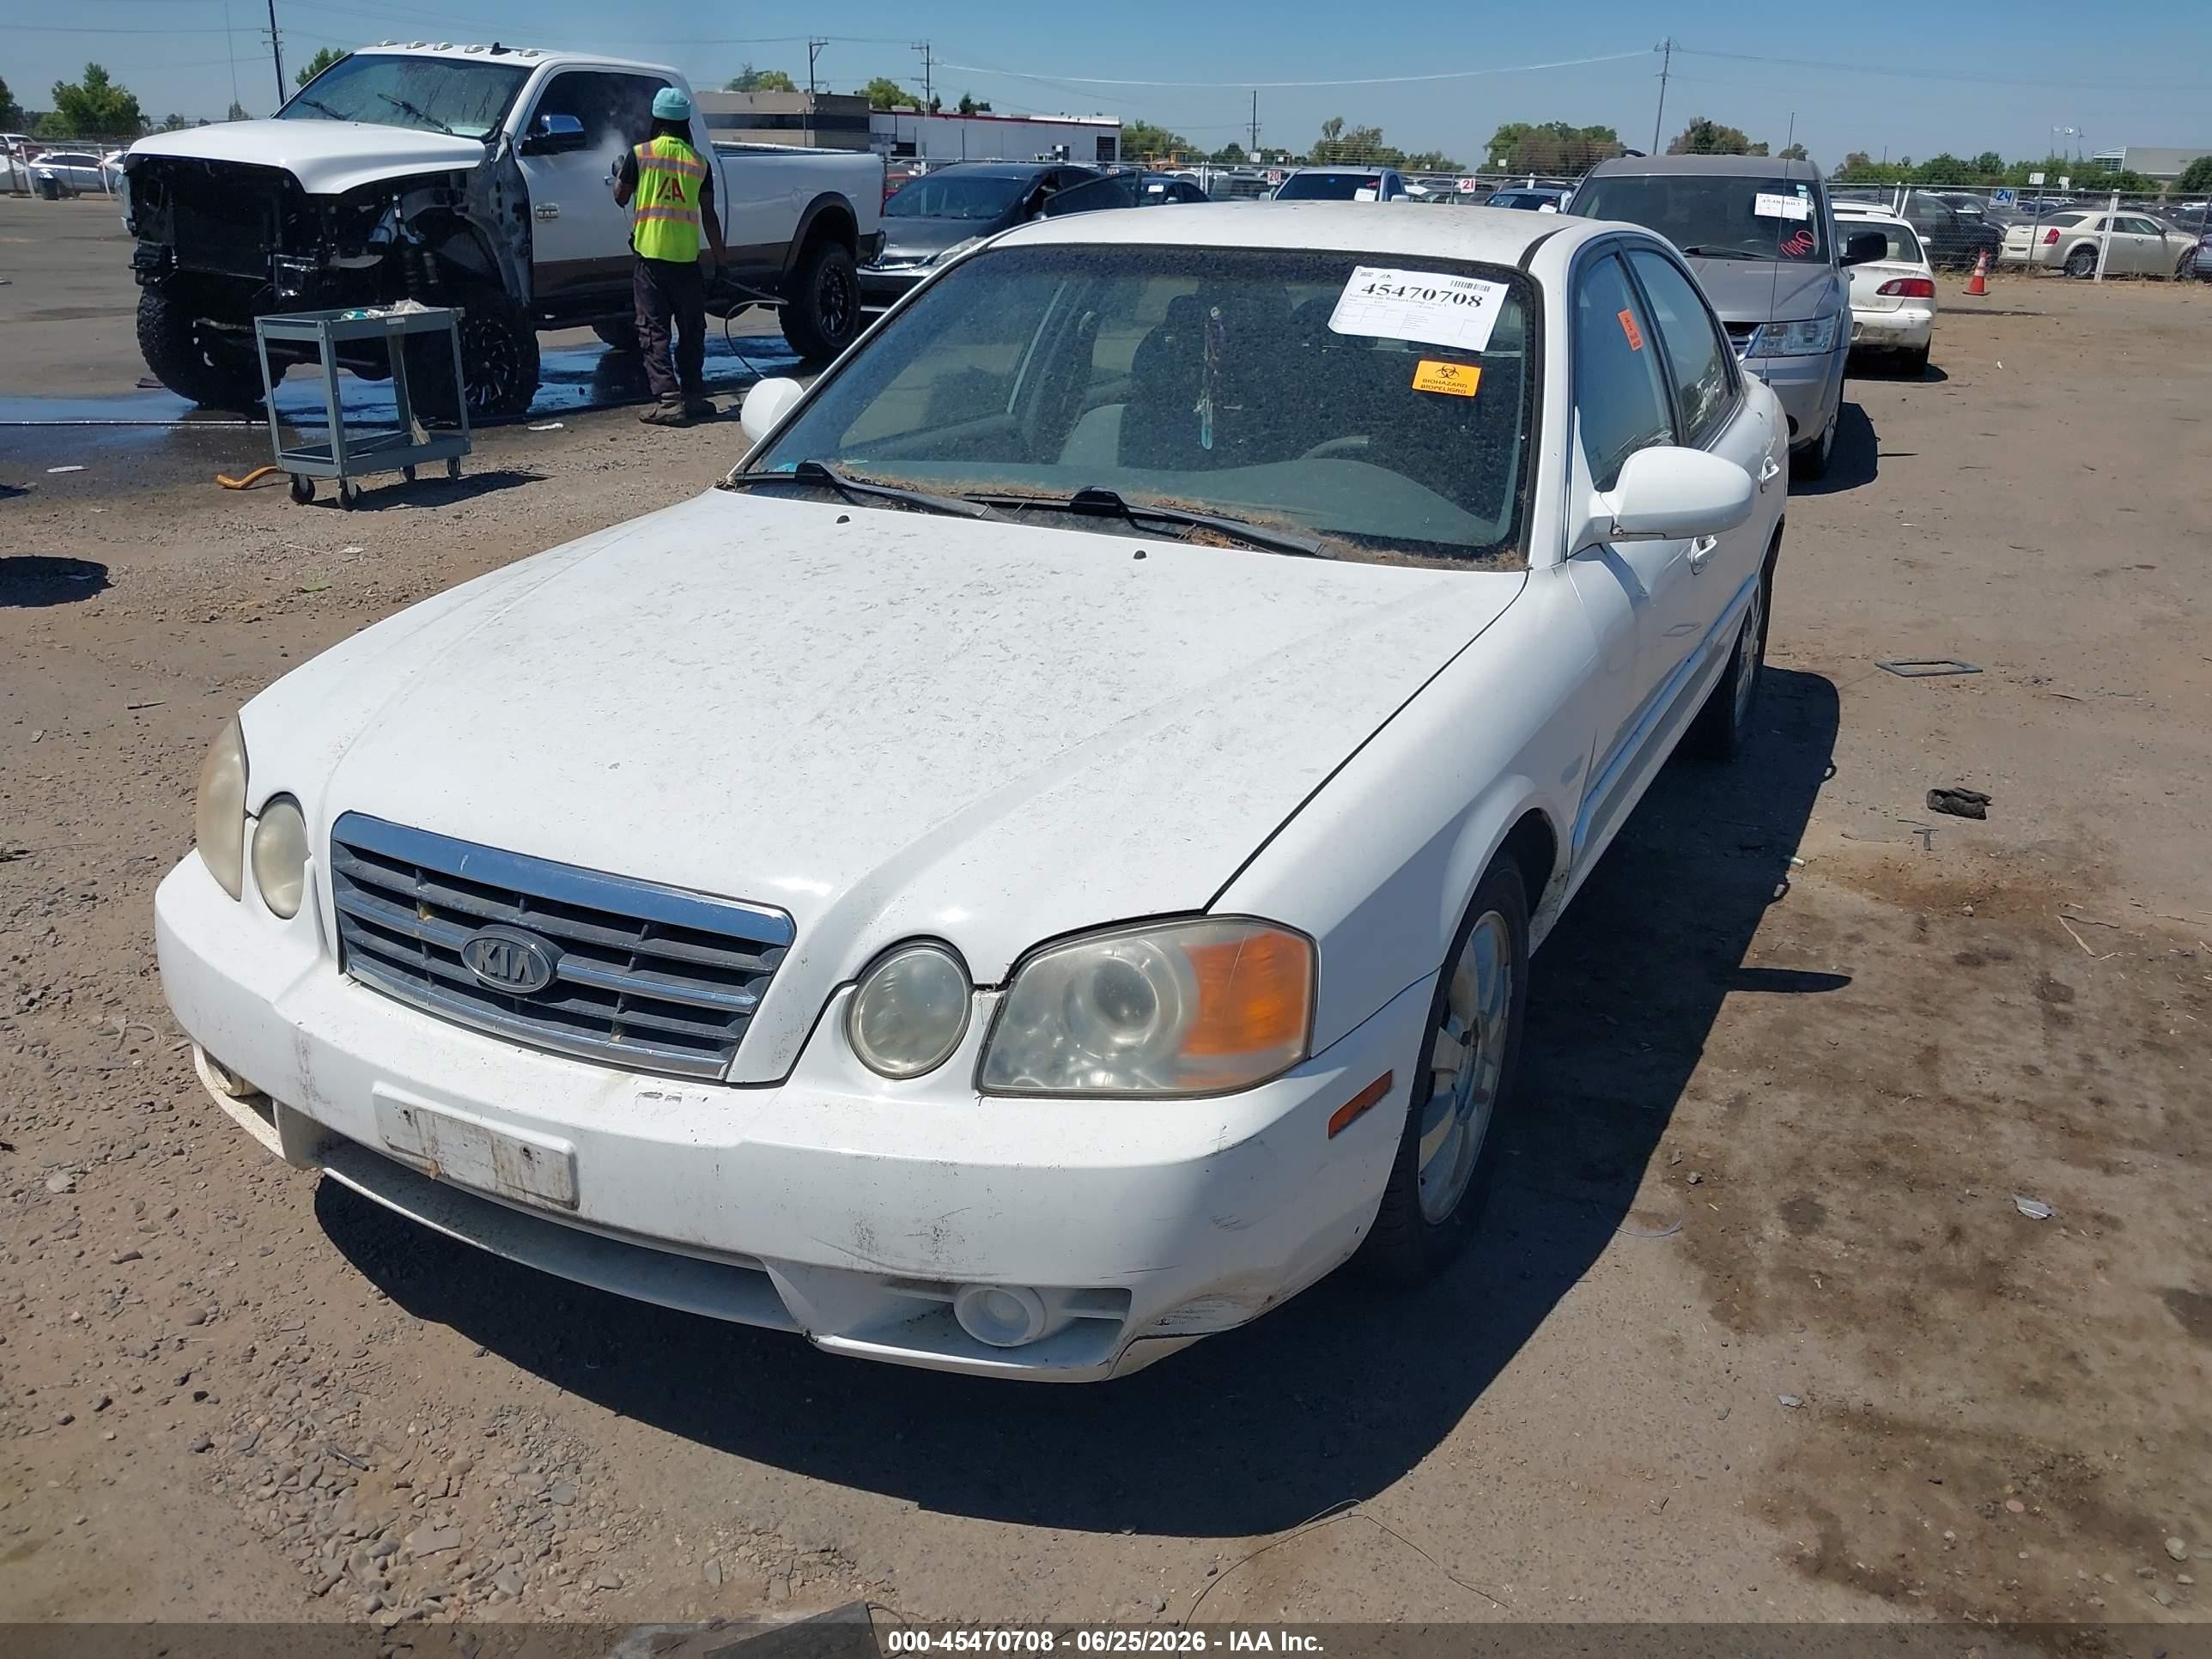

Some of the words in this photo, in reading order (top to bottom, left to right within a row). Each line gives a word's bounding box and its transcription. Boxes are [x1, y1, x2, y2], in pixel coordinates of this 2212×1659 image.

[1269, 171, 1279, 181] 20
[1462, 179, 1474, 190] 21
[1996, 189, 2013, 203] 24
[1361, 283, 1484, 308] 45470708
[1422, 378, 1468, 388] BIOHAZARD
[1420, 384, 1467, 394] BIOPELIGRO
[476, 942, 536, 985] KIA
